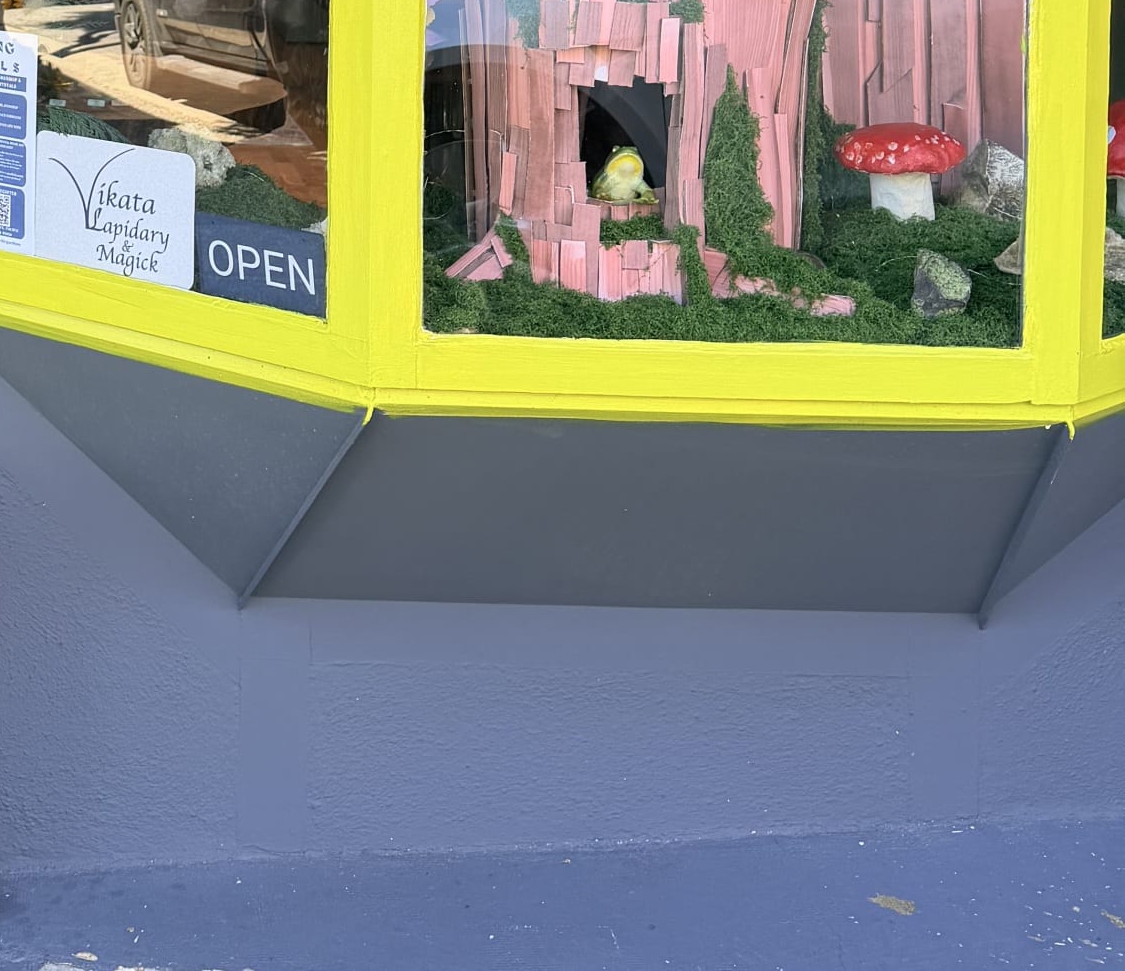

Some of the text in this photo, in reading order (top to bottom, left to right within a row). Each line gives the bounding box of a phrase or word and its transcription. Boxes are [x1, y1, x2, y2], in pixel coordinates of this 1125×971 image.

[48, 148, 156, 229] Vikata
[88, 207, 170, 254] Lapidary
[121, 239, 134, 253] &
[96, 244, 158, 277] Magick
[208, 239, 316, 296] OPEN
